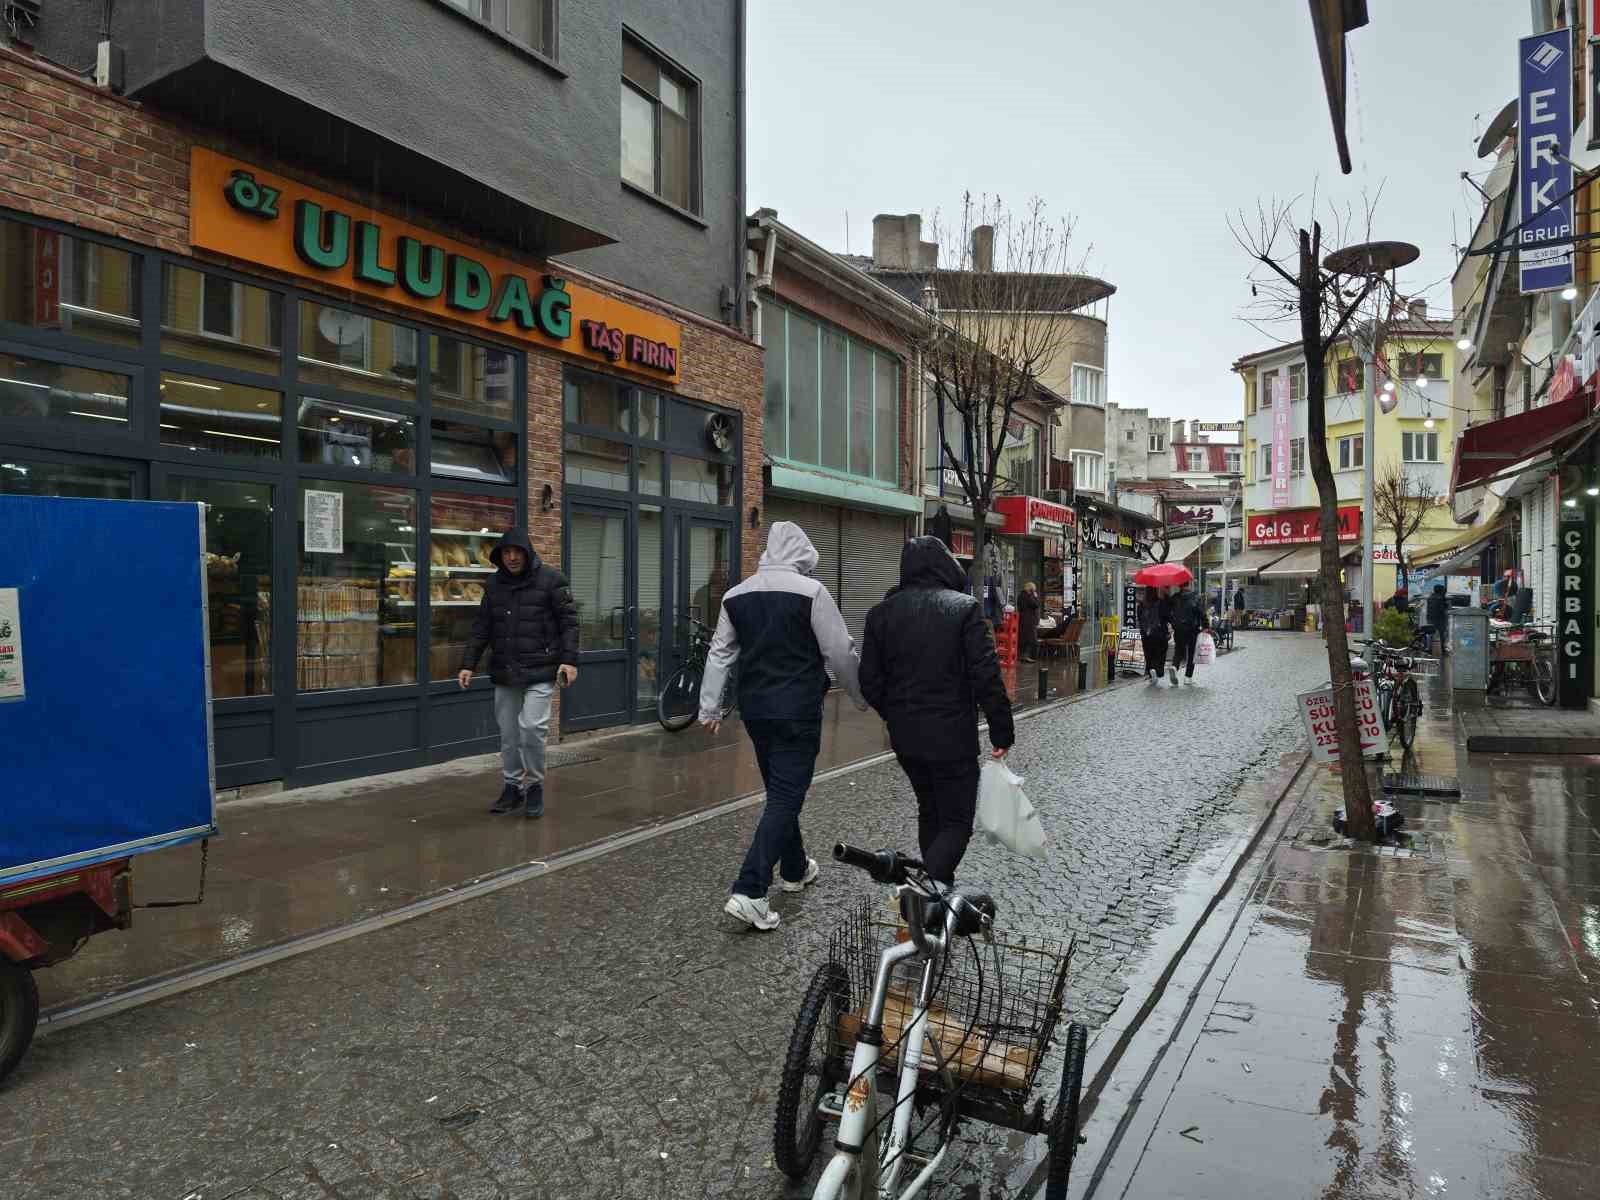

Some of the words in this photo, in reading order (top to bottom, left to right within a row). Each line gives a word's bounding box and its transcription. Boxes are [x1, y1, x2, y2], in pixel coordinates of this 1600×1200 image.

[1530, 88, 1560, 214] ERK
[1523, 225, 1570, 243] GRUP
[226, 169, 280, 218] ÖZ
[296, 200, 572, 339] ULUDAĞ
[583, 319, 623, 360] TAŞ
[1255, 522, 1277, 538] Gel
[1280, 521, 1310, 537] Gr
[1564, 530, 1582, 679] ÇORBACI
[1309, 697, 1373, 720] SÜRCÜ
[1312, 712, 1377, 735] KUSU
